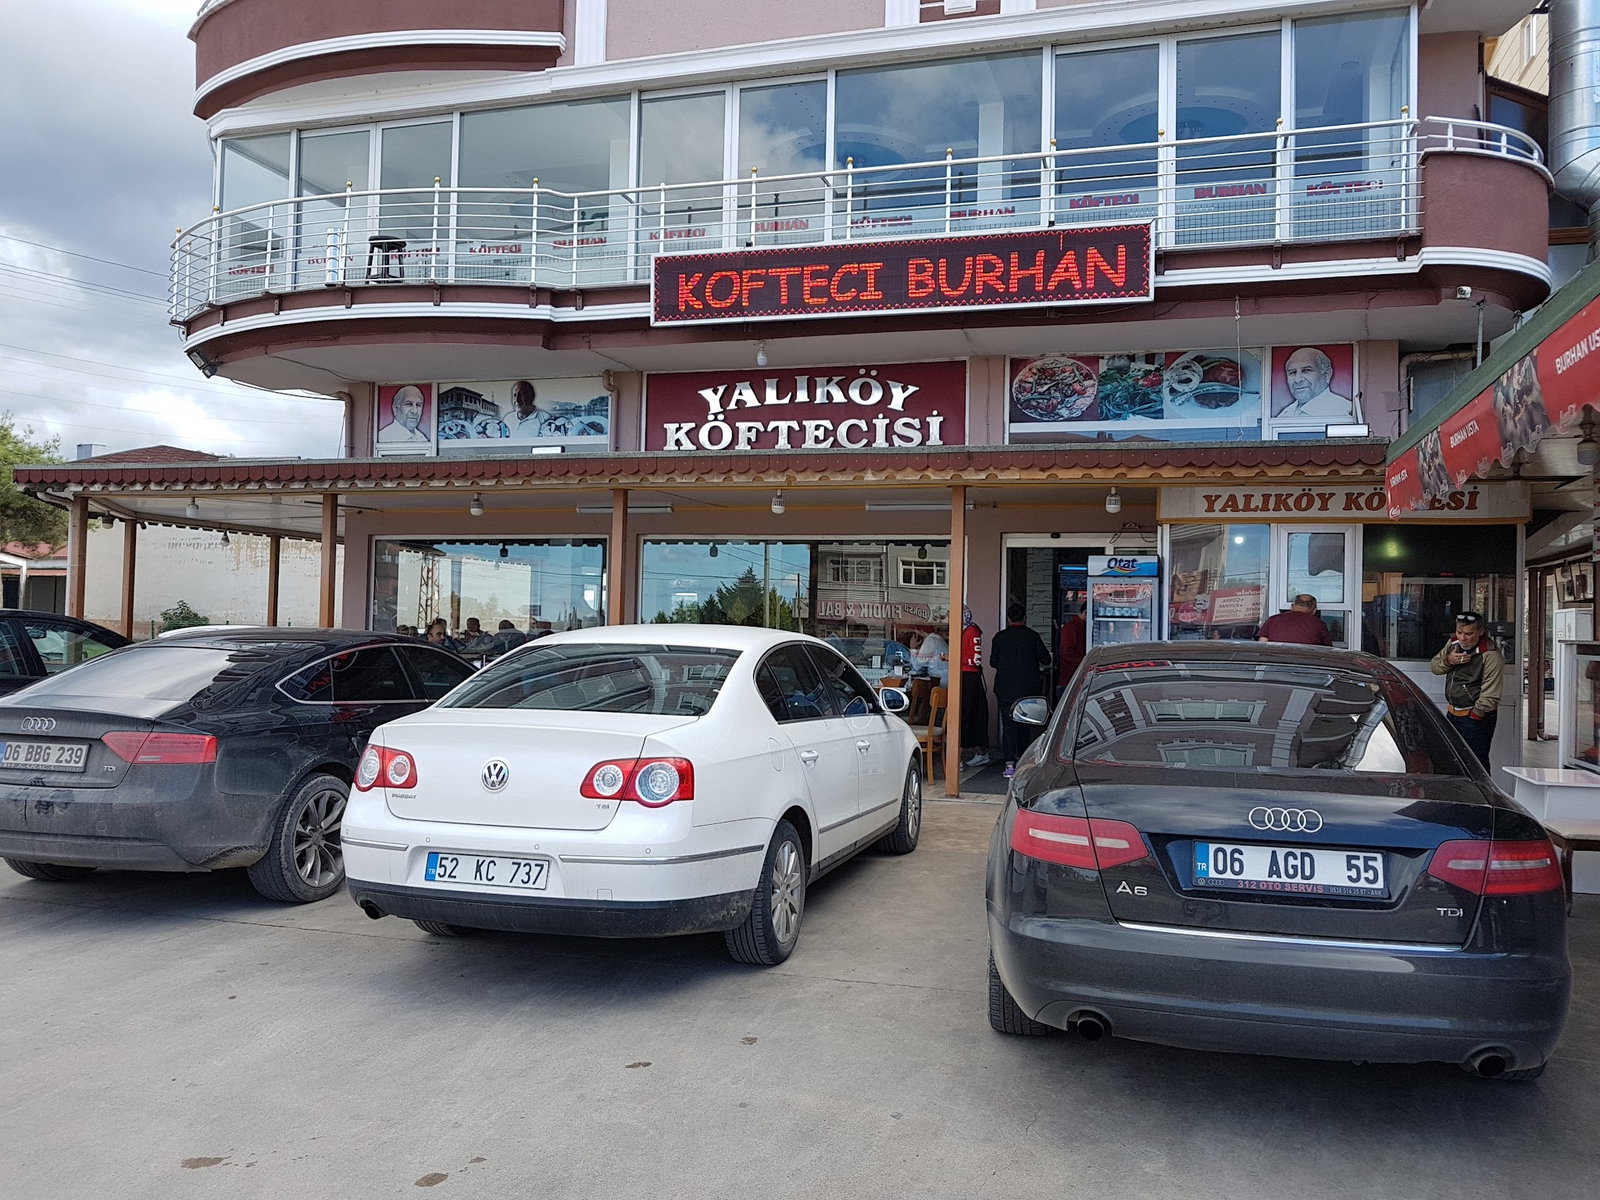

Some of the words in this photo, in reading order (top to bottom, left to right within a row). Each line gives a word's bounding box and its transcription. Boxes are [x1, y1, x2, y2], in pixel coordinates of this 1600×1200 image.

[1194, 183, 1268, 199] BURHAN
[908, 244, 1126, 298] BURHAN
[1555, 337, 1589, 375] BURHAN
[698, 368, 920, 415] YALIKÖY
[663, 409, 944, 450] KÖFTECİSİ
[1450, 425, 1468, 448] BURHAN
[1466, 419, 1480, 437] USTA
[1202, 487, 1336, 512] YALIKÖY
[1342, 486, 1480, 512] KÖESİ
[1106, 557, 1138, 570] Otat
[3, 744, 21, 761] 06
[25, 744, 51, 762] BBG
[55, 746, 83, 765] 239
[438, 857, 459, 879] 52
[474, 859, 497, 882] KC
[509, 861, 544, 886] 737
[1197, 862, 1207, 871] TR
[1213, 846, 1244, 876] 06
[1268, 850, 1315, 880] AGD
[1346, 854, 1379, 885] 55
[1116, 880, 1148, 896] A6
[1237, 880, 1257, 889] 312
[1260, 881, 1281, 891] OTO
[1436, 907, 1463, 917] TDI
